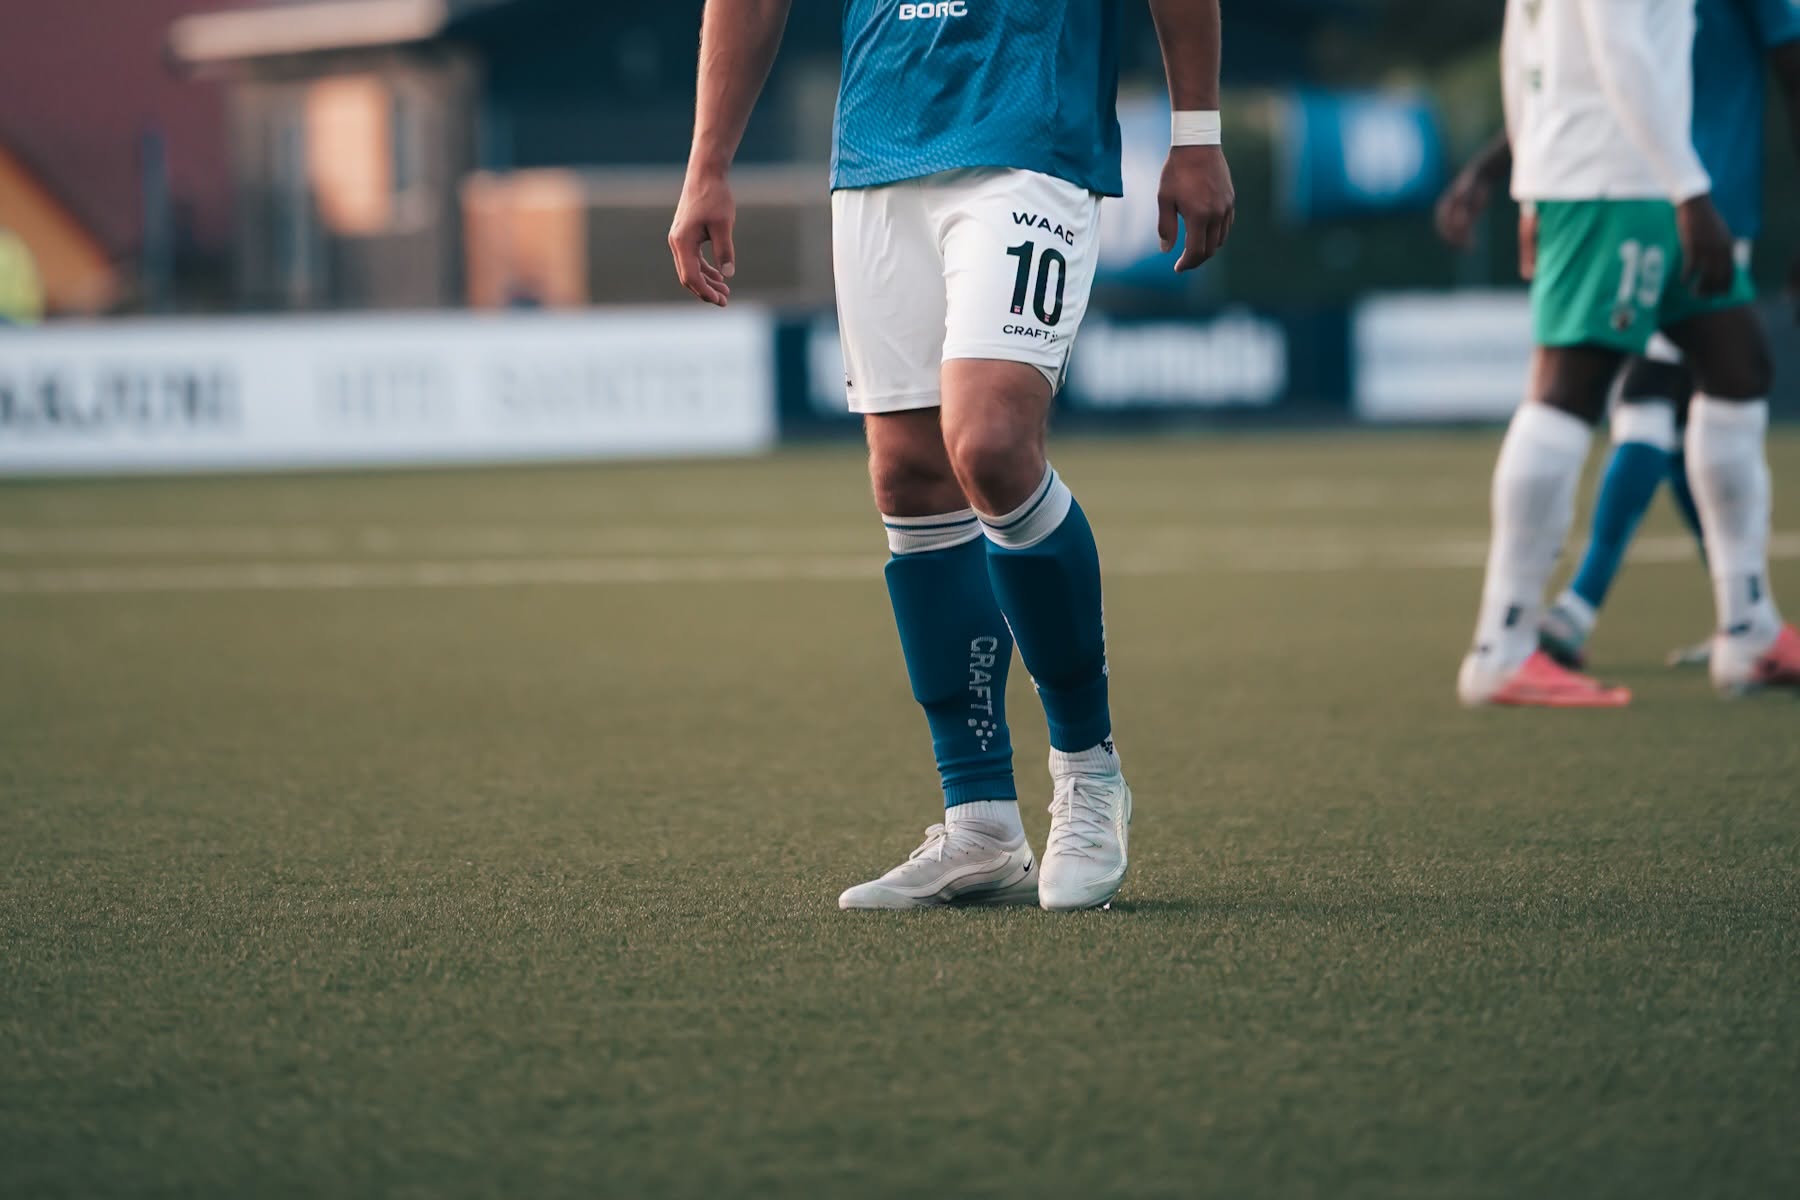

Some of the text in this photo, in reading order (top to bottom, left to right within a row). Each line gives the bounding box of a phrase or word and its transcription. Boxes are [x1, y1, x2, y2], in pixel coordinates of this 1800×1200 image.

[1012, 211, 1075, 246] WAAG
[1006, 240, 1066, 327] 10
[1614, 239, 1664, 308] 19
[1003, 324, 1051, 341] CRAFT
[968, 635, 998, 717] CRAFT
